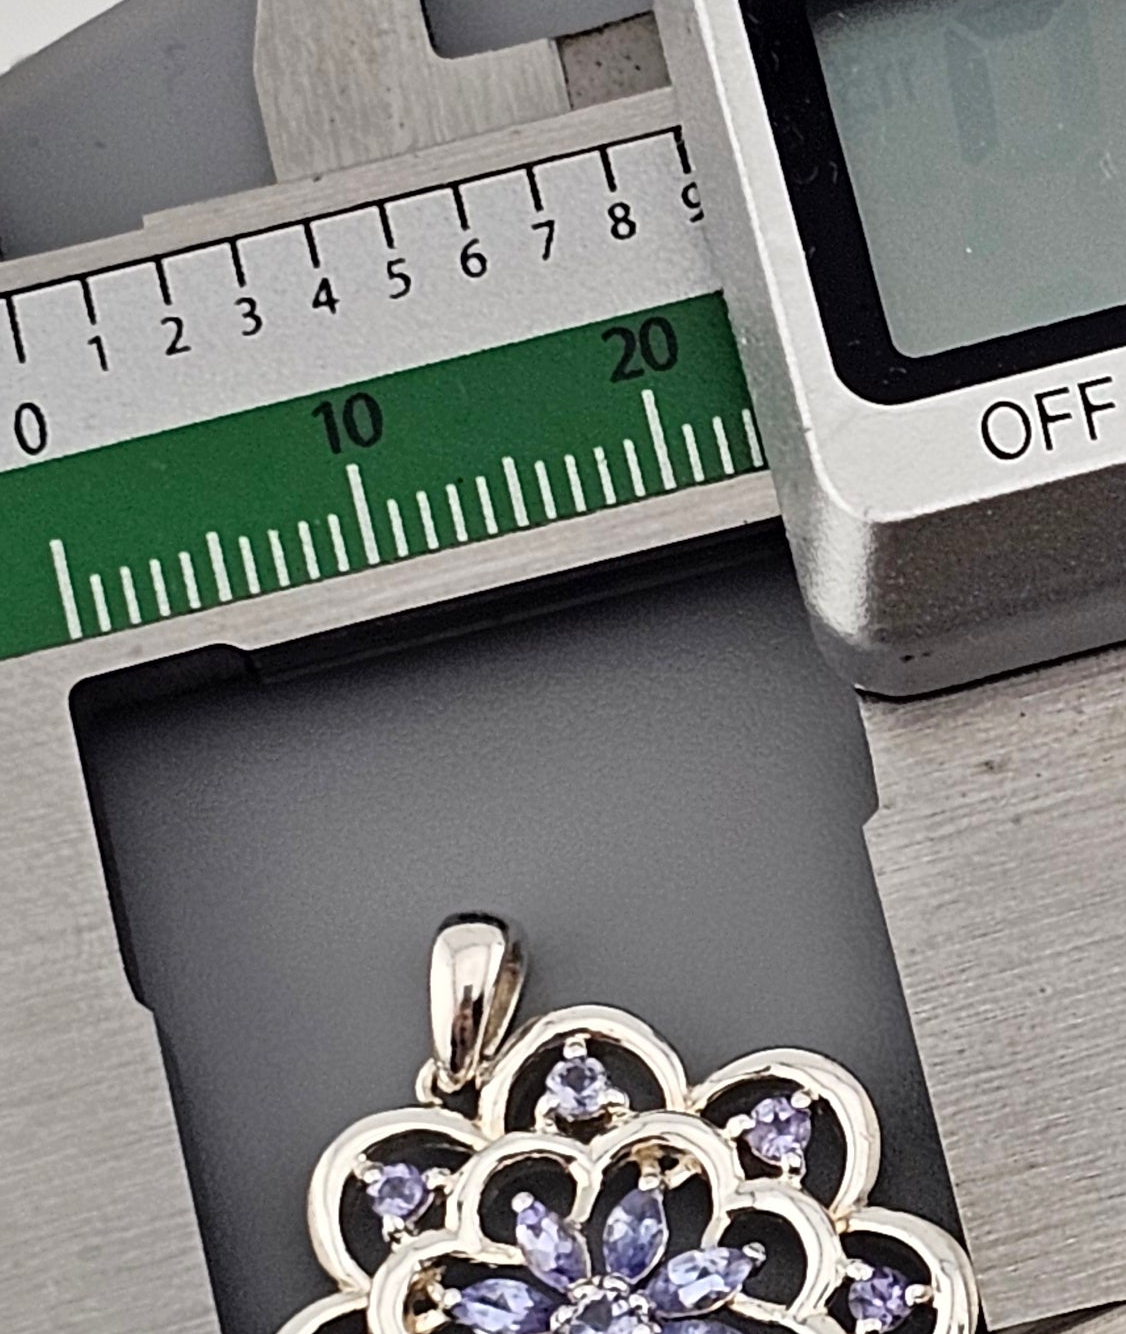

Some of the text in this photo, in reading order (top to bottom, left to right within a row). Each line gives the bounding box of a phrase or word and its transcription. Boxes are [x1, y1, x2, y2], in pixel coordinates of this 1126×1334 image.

[13, 402, 48, 456] 0
[87, 335, 109, 371] 1
[160, 316, 190, 355] 2
[237, 298, 263, 336] 3
[311, 277, 340, 314] 4
[385, 259, 412, 299] 5
[459, 240, 488, 278] 6
[530, 221, 557, 261] 7
[608, 202, 637, 240] 8
[311, 317, 679, 454] 10 20
[981, 376, 1116, 461] OFF
